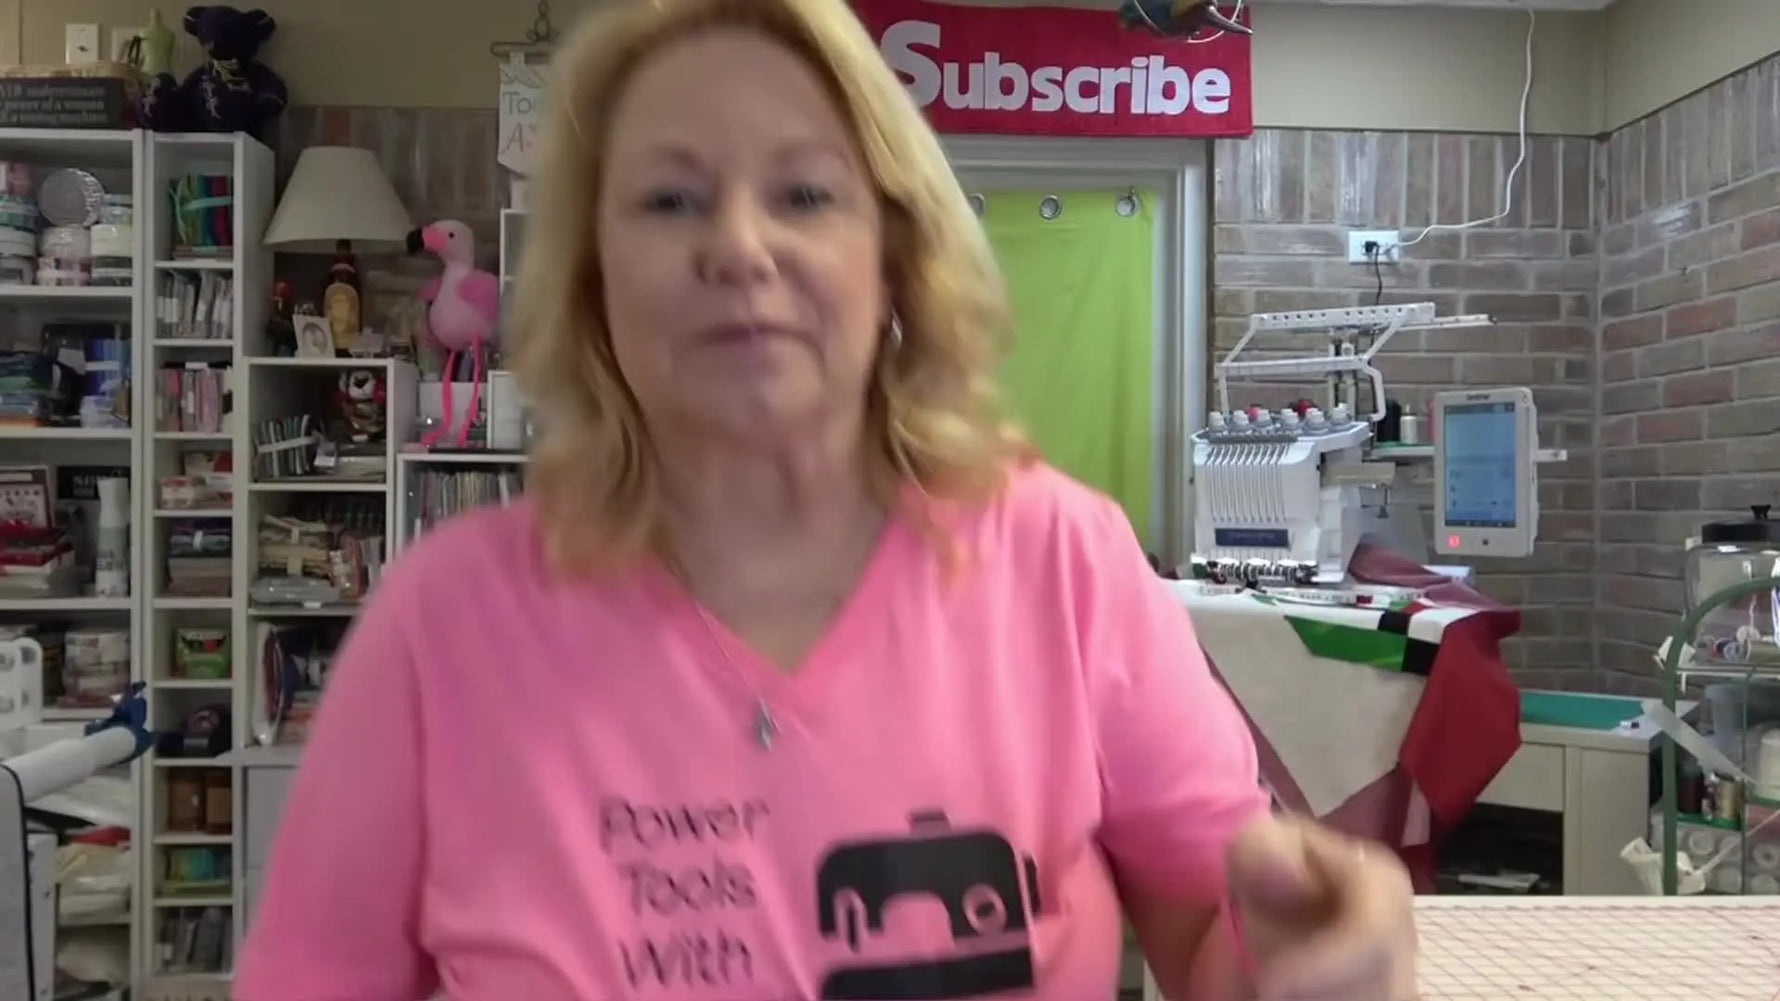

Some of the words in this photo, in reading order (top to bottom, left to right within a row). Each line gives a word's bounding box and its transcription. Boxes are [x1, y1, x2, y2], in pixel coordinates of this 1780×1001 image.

[880, 20, 1231, 115] Subscribe
[600, 797, 769, 853] Power
[617, 854, 757, 918] Tools
[618, 926, 754, 988] With
